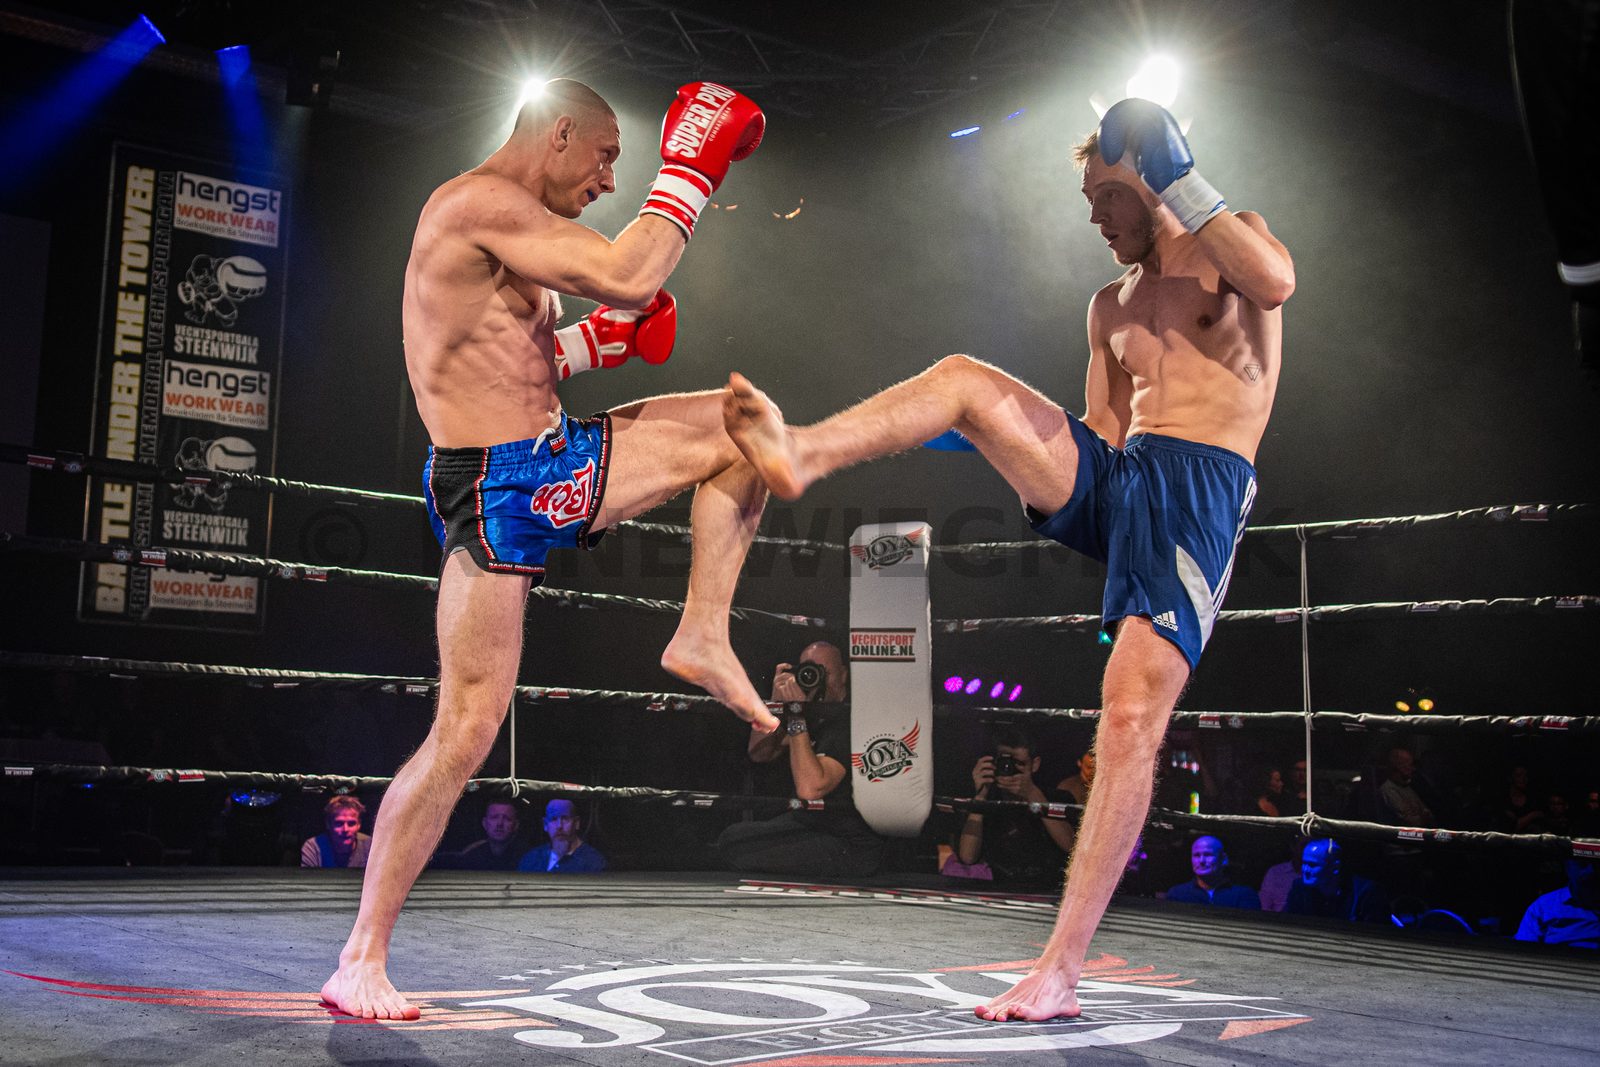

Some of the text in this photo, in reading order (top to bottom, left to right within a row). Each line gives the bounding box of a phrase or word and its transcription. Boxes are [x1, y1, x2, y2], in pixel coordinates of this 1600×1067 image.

[666, 104, 717, 158] SUPER
[179, 173, 277, 213] hengst
[119, 165, 155, 287] TOWER
[177, 203, 276, 234] WORKWEAR
[147, 170, 174, 348] VECHTSPORTGALA
[115, 291, 145, 355] THE
[175, 323, 259, 347] VECHTSPORTGALA
[174, 336, 258, 365] STEENWIJK
[167, 361, 267, 398] hengst
[141, 350, 163, 455] MEMORIAL
[165, 392, 265, 416] WORKWEAR
[162, 522, 248, 546] STEENWIJK
[163, 510, 249, 529] VECHTSPORTGALA
[96, 482, 133, 613] BATLE
[153, 580, 255, 600] WORKWEAR
[1152, 616, 1178, 631] adidas
[851, 634, 915, 645] VECHTSPORT
[851, 645, 915, 656] ONLINE.NL
[860, 741, 918, 775] JOYA
